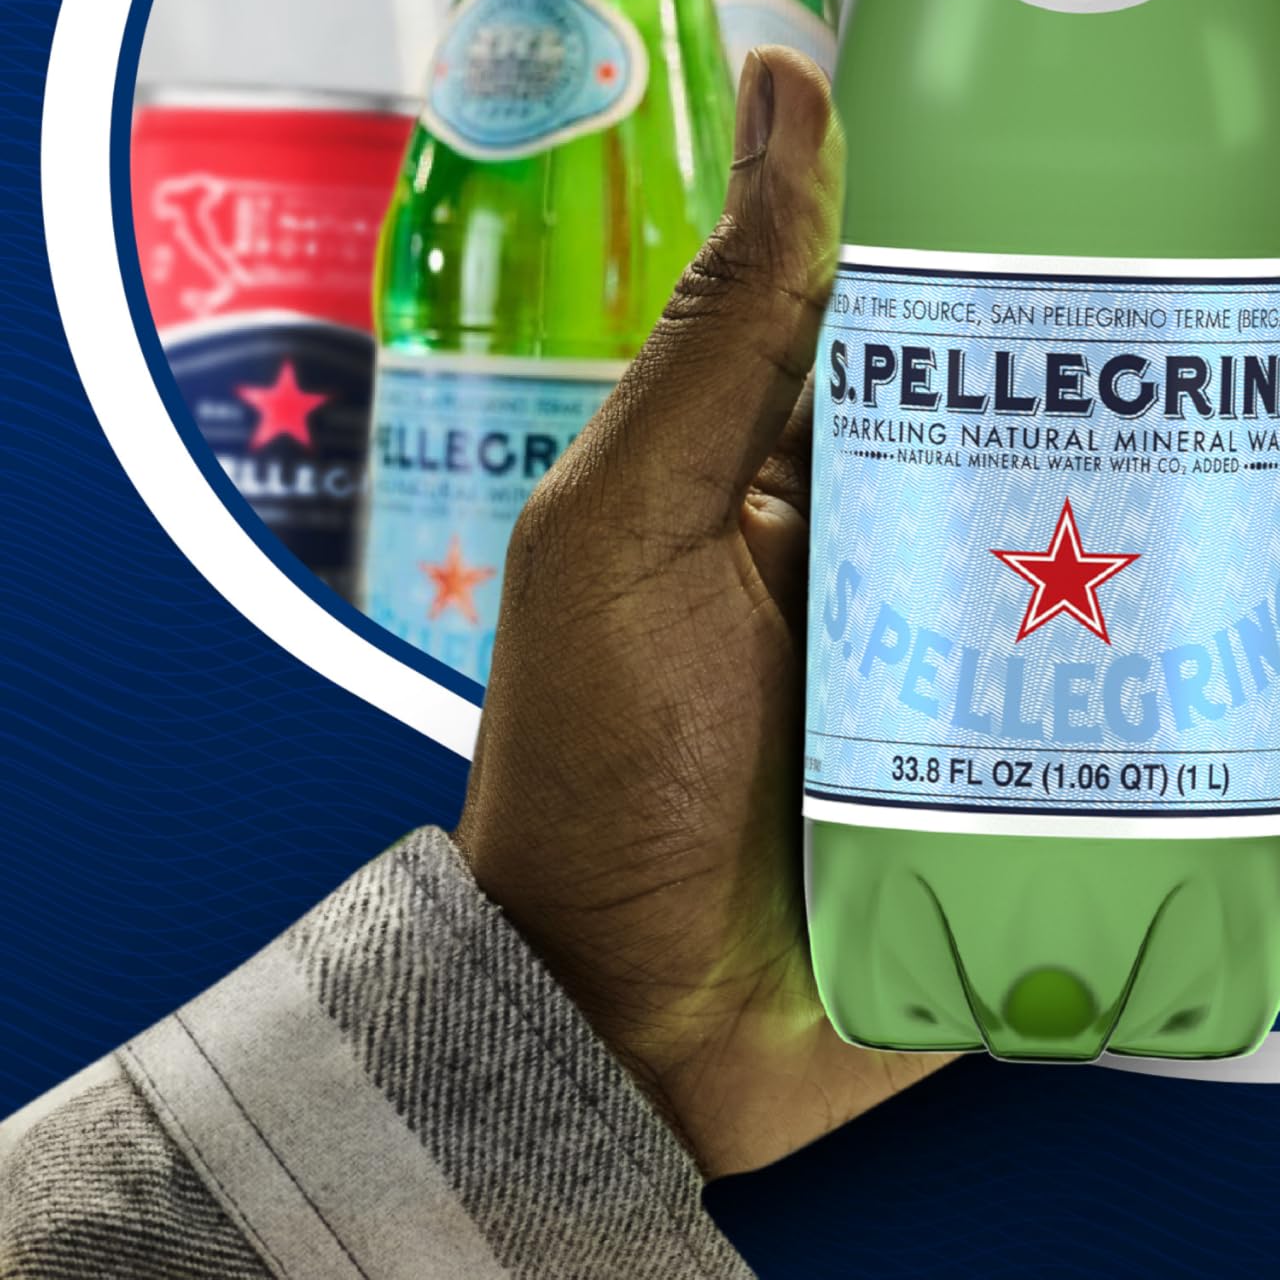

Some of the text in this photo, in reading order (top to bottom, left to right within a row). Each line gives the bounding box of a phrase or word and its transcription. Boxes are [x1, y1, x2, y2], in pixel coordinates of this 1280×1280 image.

[853, 296, 866, 316] AT
[872, 297, 896, 318] THE
[903, 299, 982, 327] SOURCE,
[990, 304, 1034, 324] SAN
[1044, 306, 1167, 329] PELLEGRINO
[1174, 309, 1230, 329] TERME
[833, 415, 946, 446] SPARKLING
[961, 424, 1098, 452] NATURAL
[1114, 430, 1237, 453] MINERAL
[898, 448, 961, 467] NATURAL
[968, 452, 1040, 470] MINERAL
[1048, 455, 1101, 473] WATER
[1110, 457, 1150, 474] WITH
[1192, 457, 1239, 474] ADDED
[892, 755, 1230, 797] 33.8 FL OZ (1.06 QT) (1 L)
